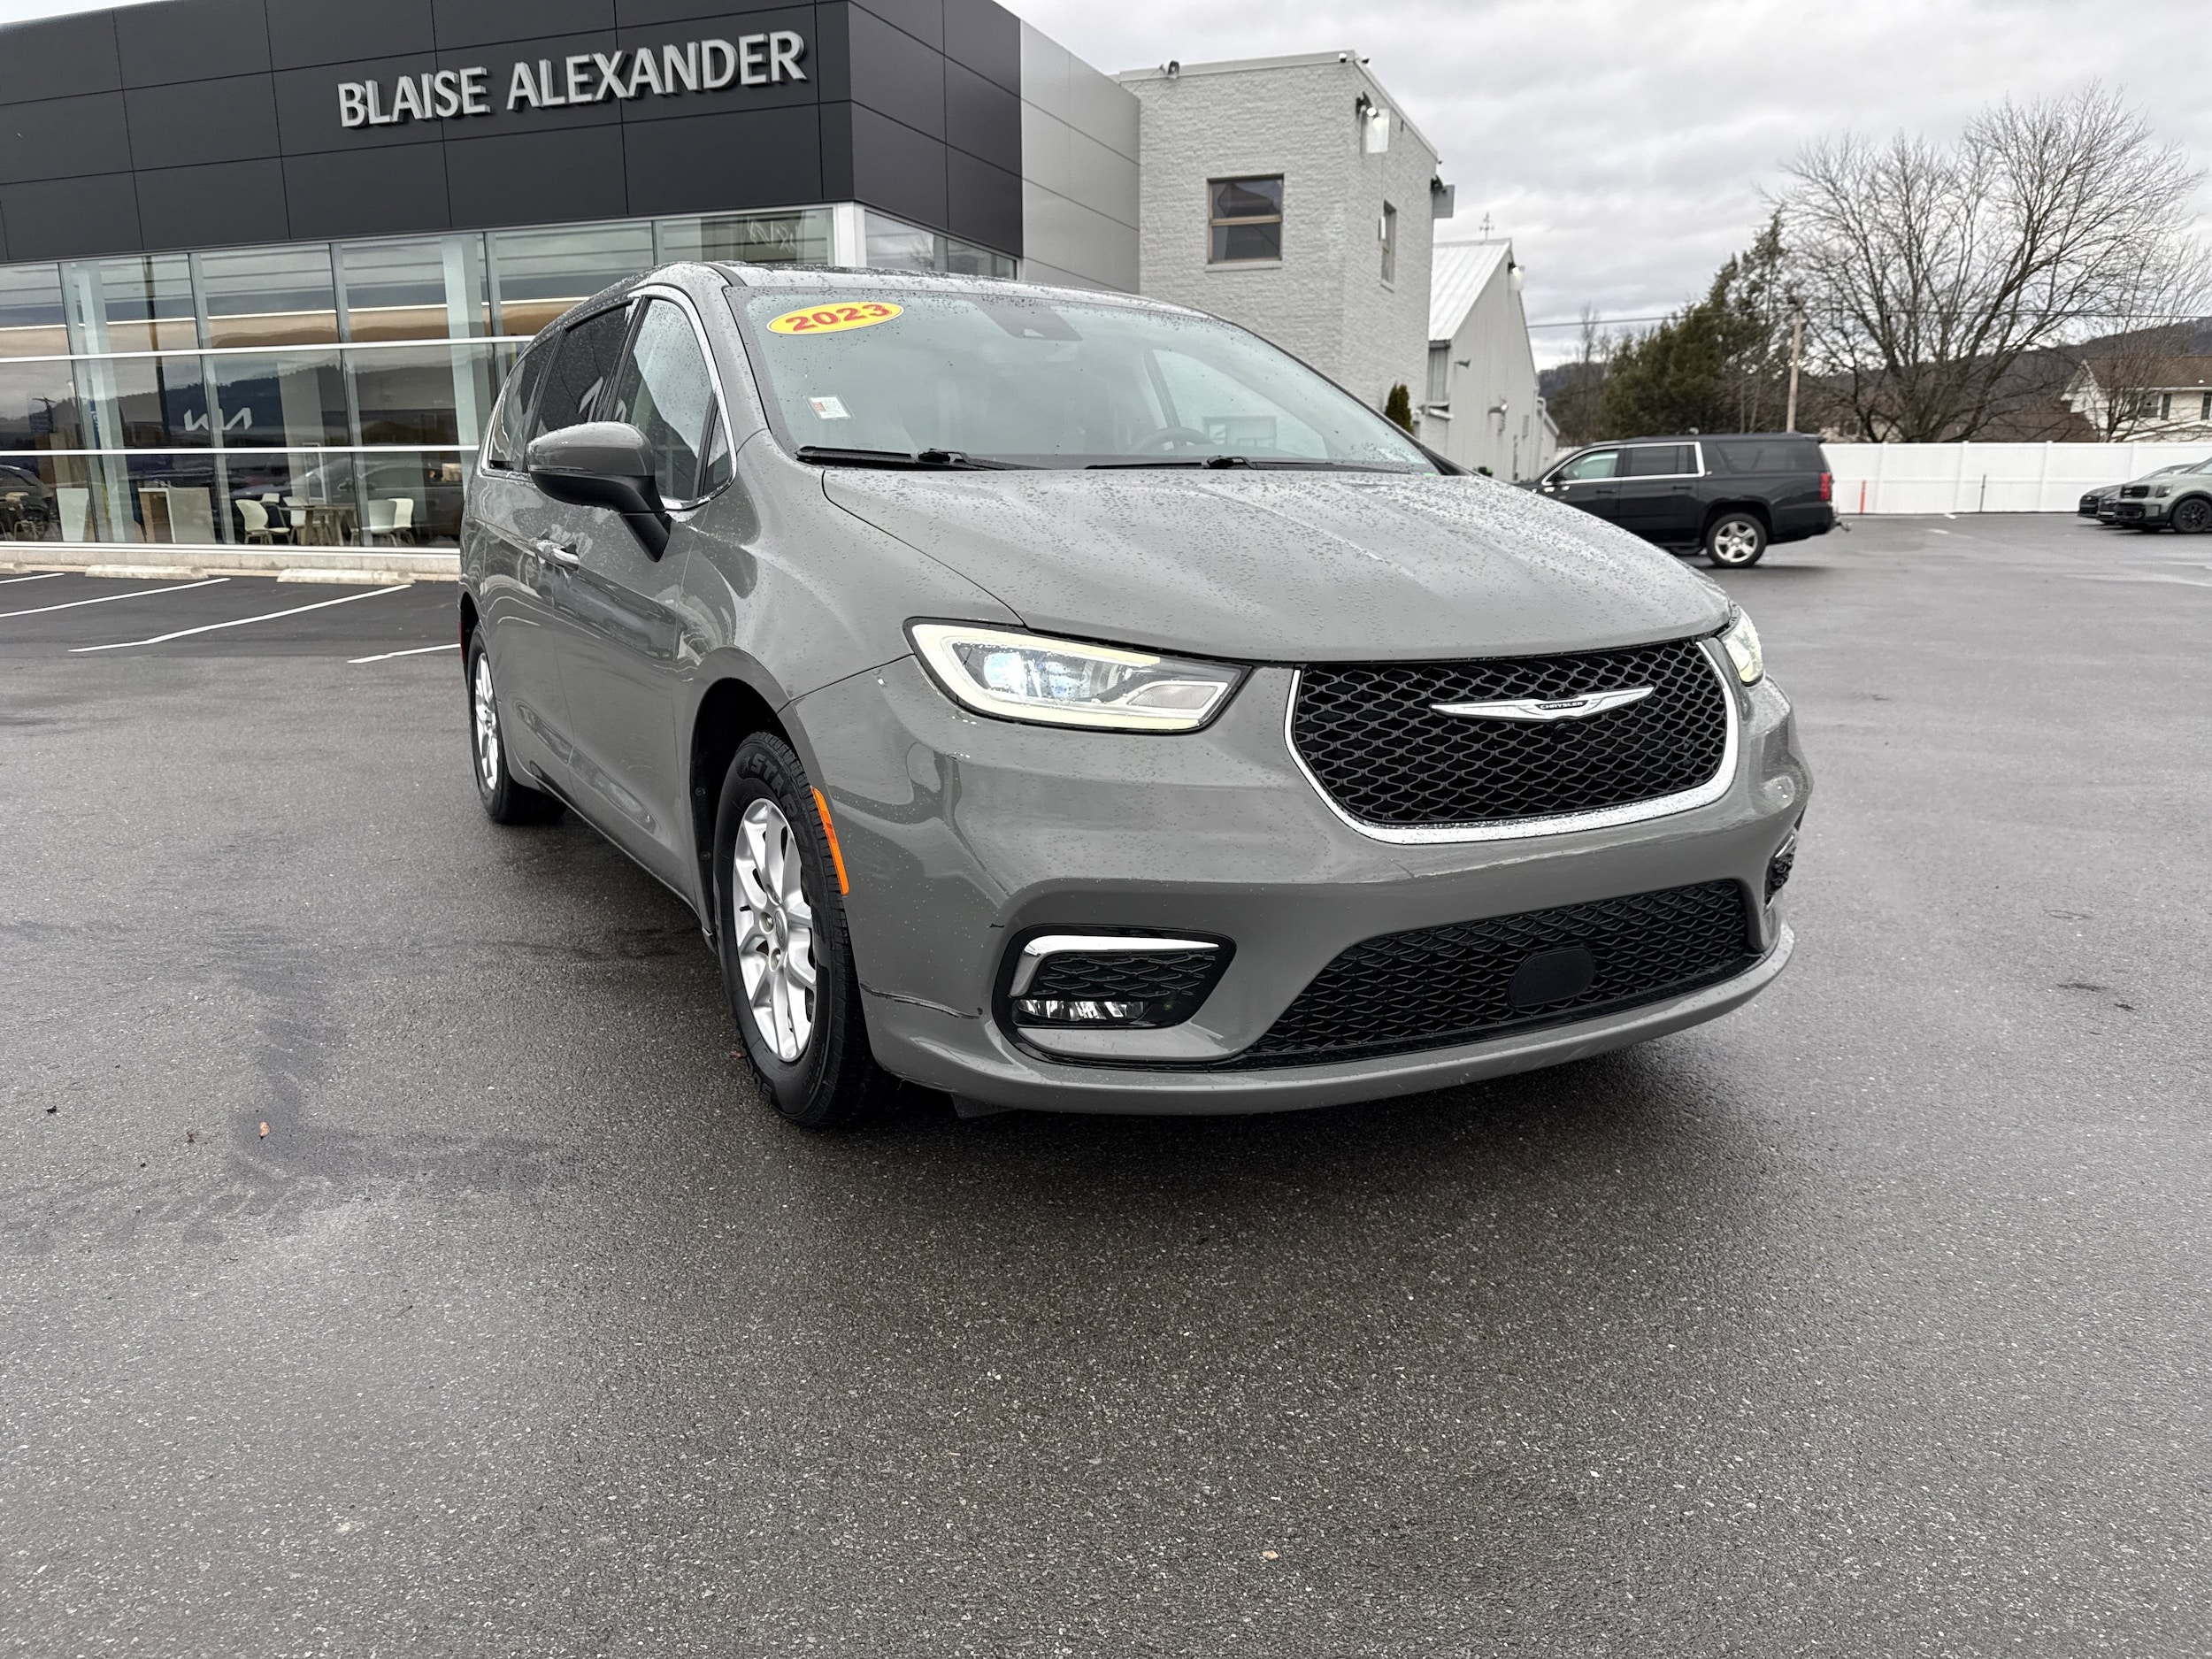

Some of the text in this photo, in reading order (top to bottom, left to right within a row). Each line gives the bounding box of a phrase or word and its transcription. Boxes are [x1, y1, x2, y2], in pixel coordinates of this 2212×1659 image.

[338, 30, 807, 127] BLAISE ALEXANDER
[786, 303, 891, 332] 2023
